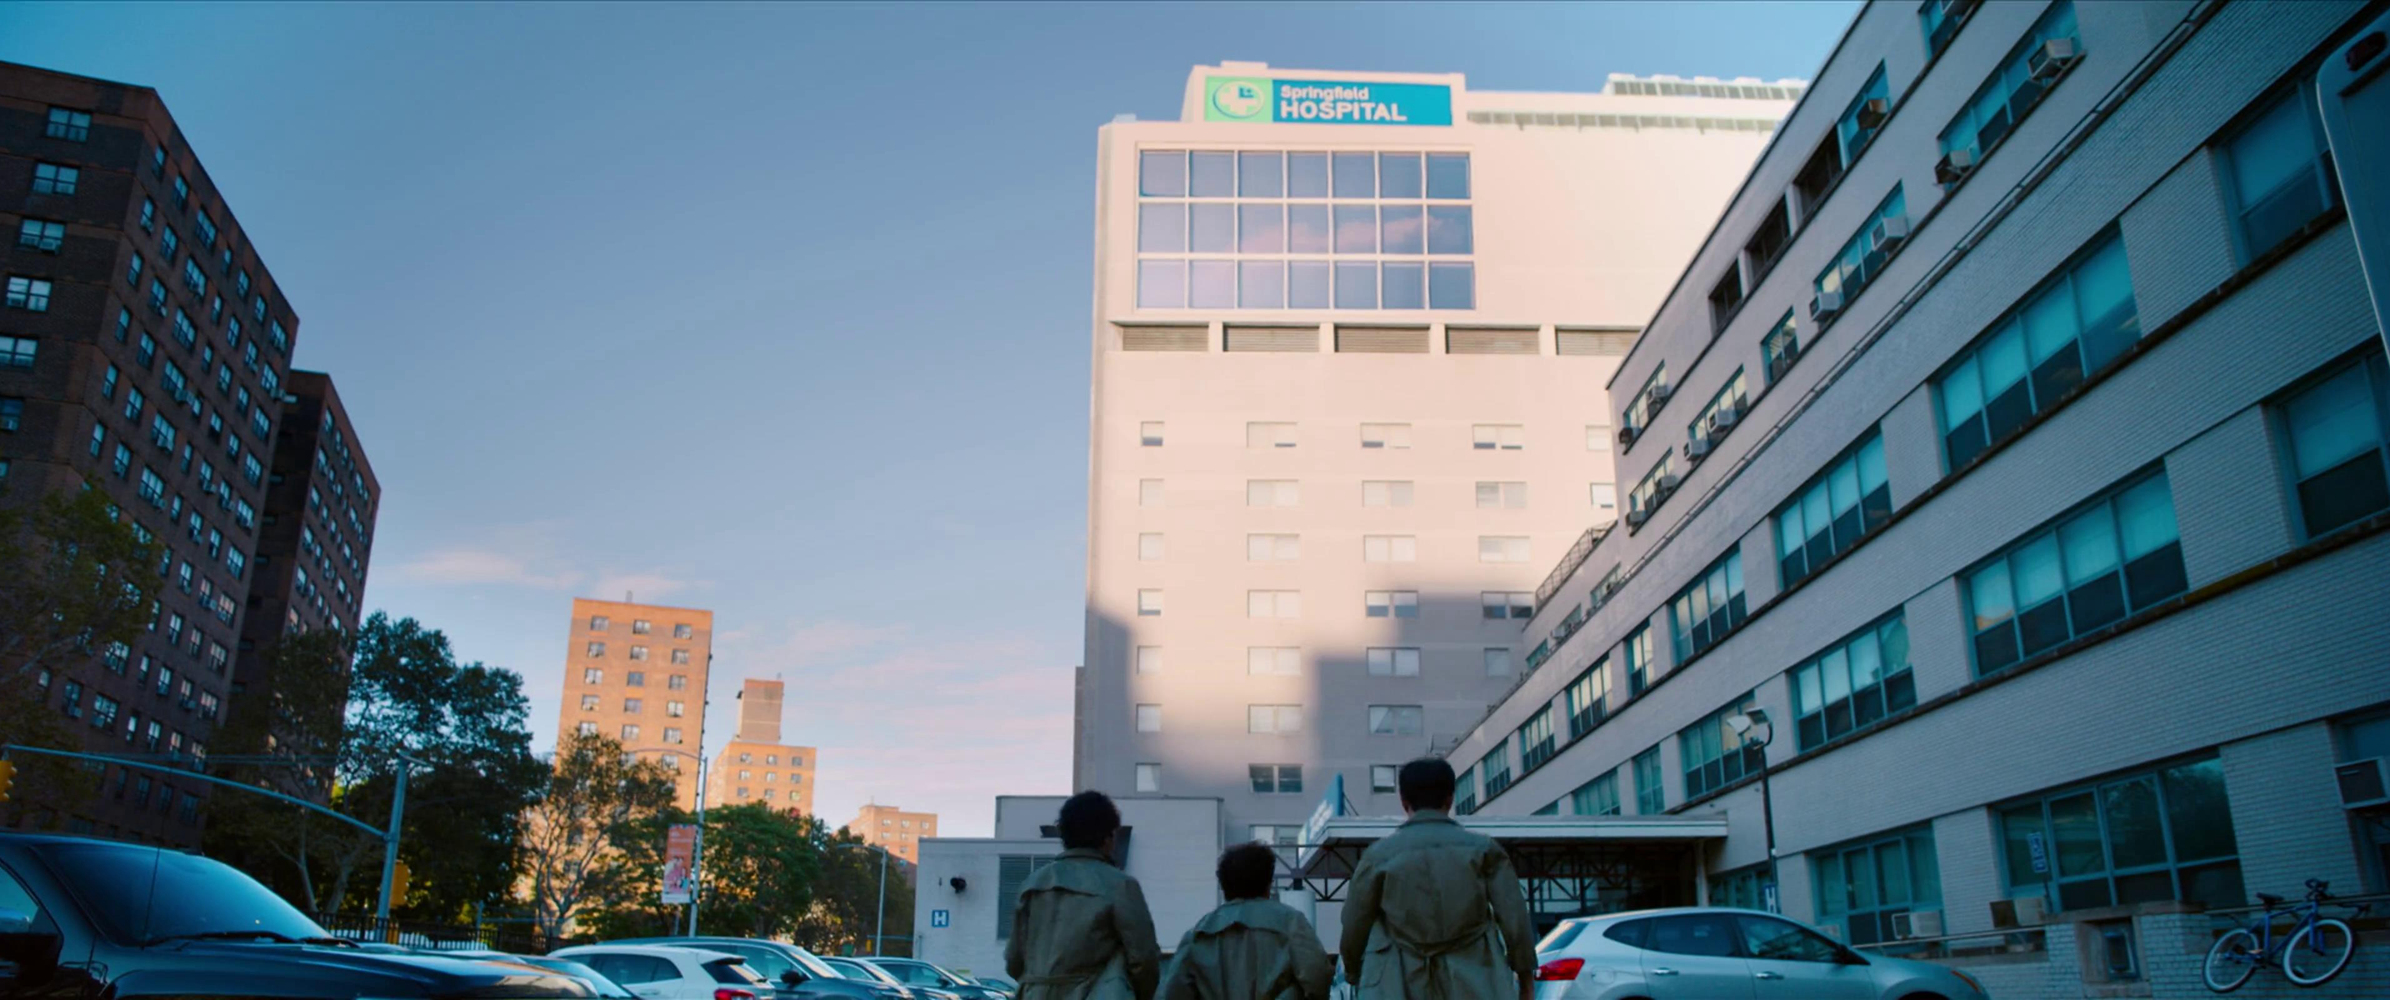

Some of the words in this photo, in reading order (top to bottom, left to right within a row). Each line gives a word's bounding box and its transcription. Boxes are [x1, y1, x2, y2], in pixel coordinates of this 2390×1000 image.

[1281, 85, 1369, 102] Springfield
[1281, 100, 1407, 121] HOSPITAL
[934, 911, 947, 926] H
